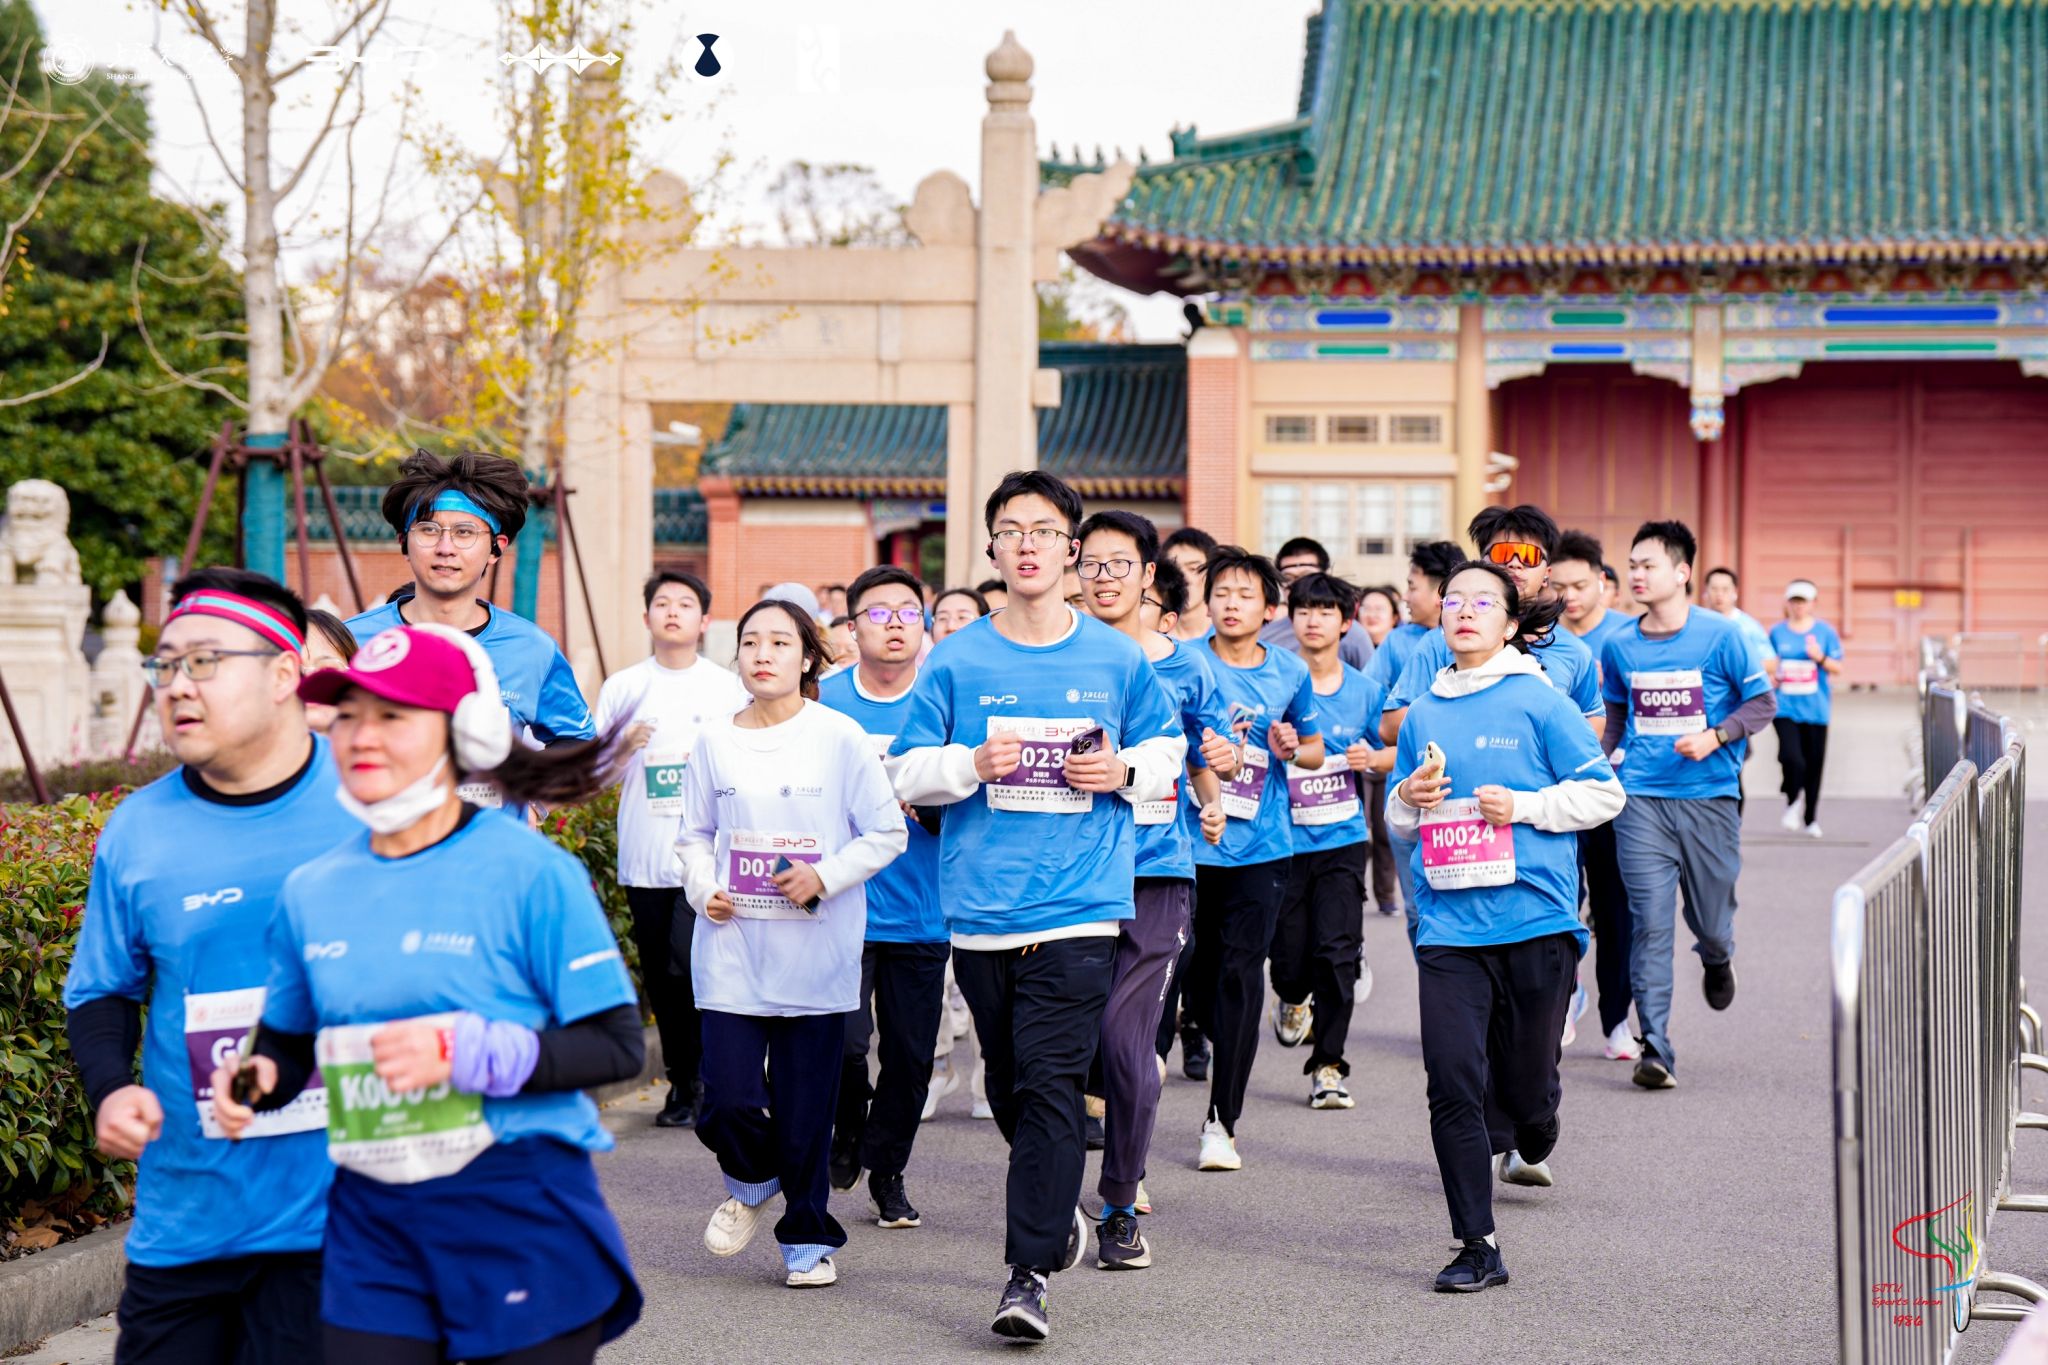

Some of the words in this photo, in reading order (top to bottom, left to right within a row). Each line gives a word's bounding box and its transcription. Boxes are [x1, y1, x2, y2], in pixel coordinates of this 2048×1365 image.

[979, 695, 1018, 705] BYD
[1641, 690, 1691, 706] G0006
[1021, 747, 1072, 768] 023
[714, 787, 736, 798] BYD
[1300, 775, 1347, 795] G0221
[773, 838, 816, 847] BYD
[1432, 824, 1496, 849] H0024
[739, 857, 776, 877] D01
[183, 887, 243, 911] BYD
[303, 941, 348, 961] BYD
